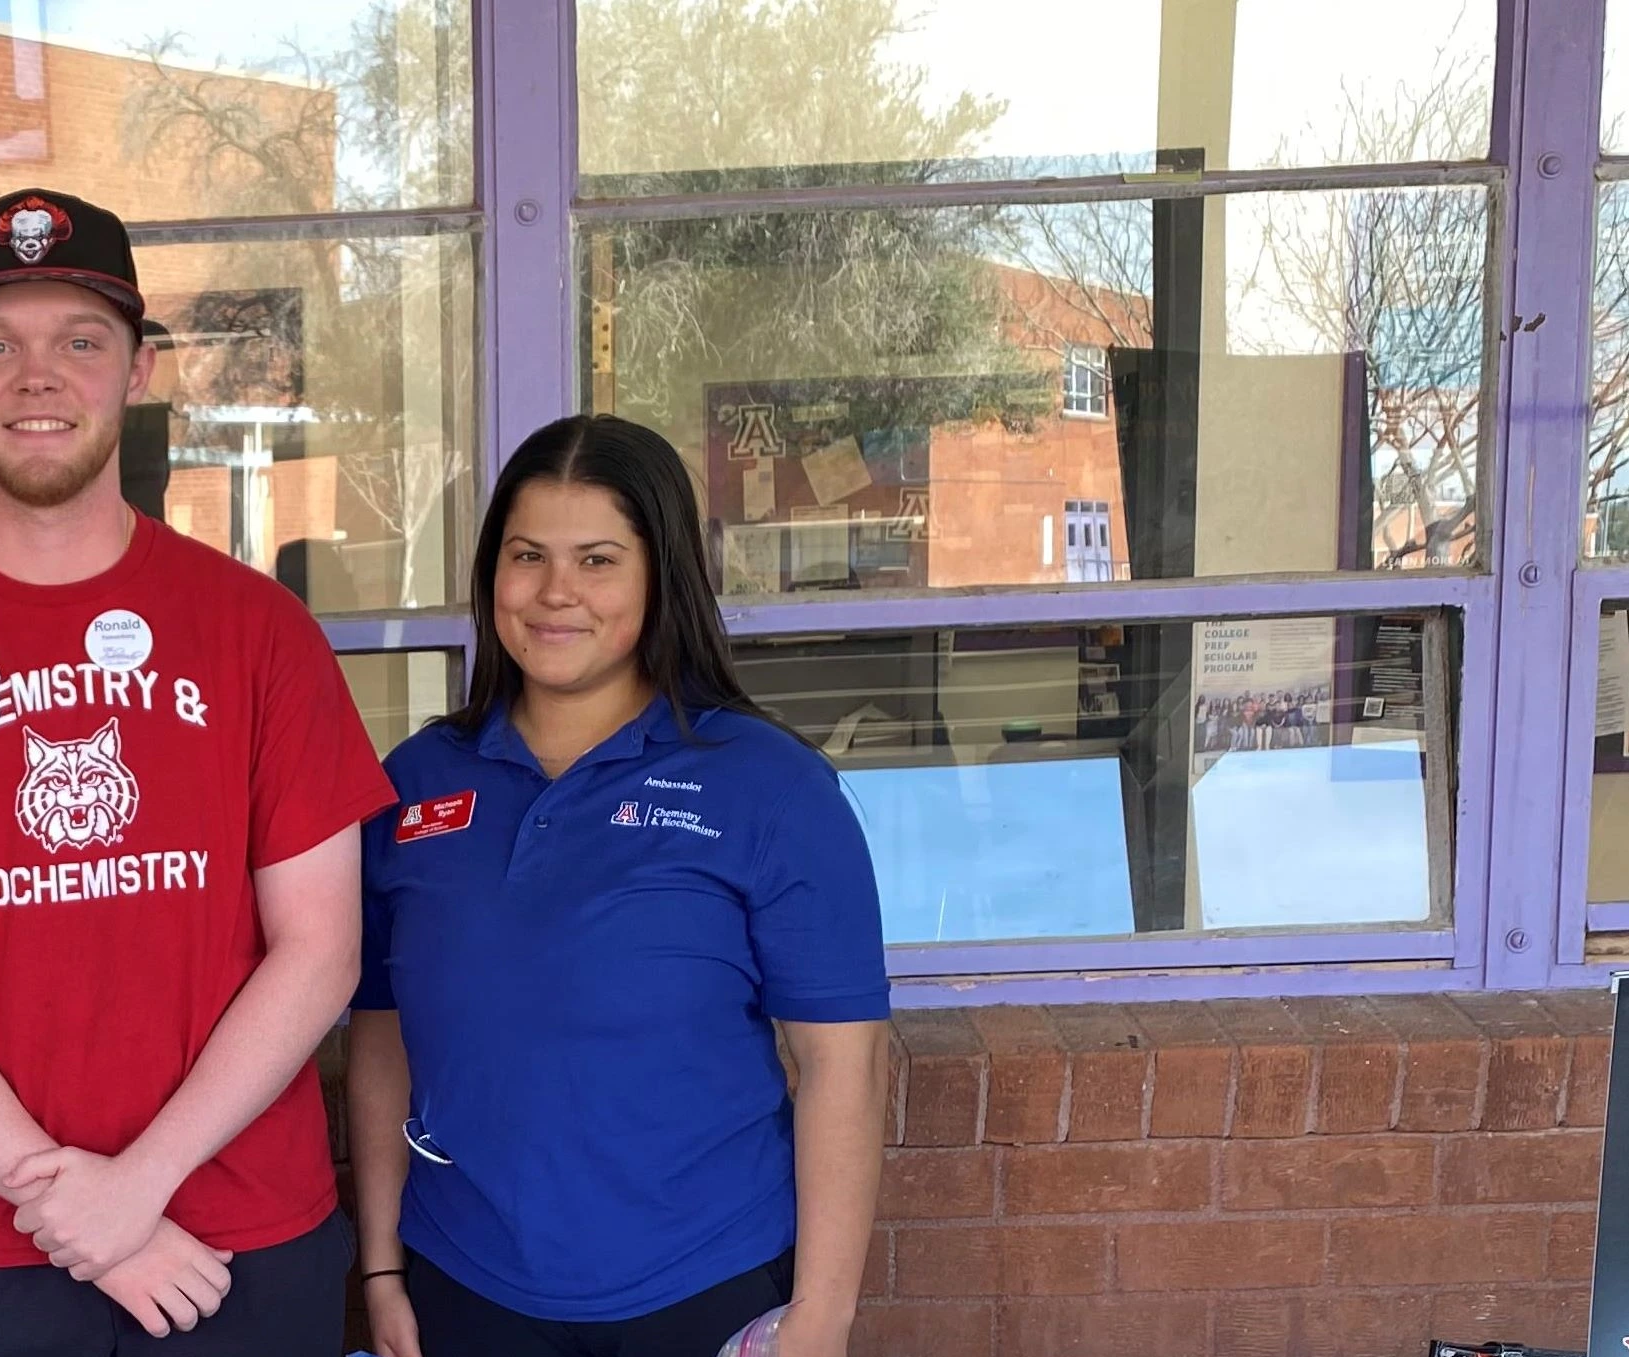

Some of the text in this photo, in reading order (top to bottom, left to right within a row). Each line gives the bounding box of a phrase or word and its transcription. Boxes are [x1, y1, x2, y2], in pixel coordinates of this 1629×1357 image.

[93, 618, 142, 632] Ronald
[1204, 628, 1250, 639] COLLEGE
[173, 677, 209, 727] &
[644, 776, 703, 792] Ambassador
[653, 806, 702, 825] Chemistry
[661, 817, 722, 839] Biochemistry
